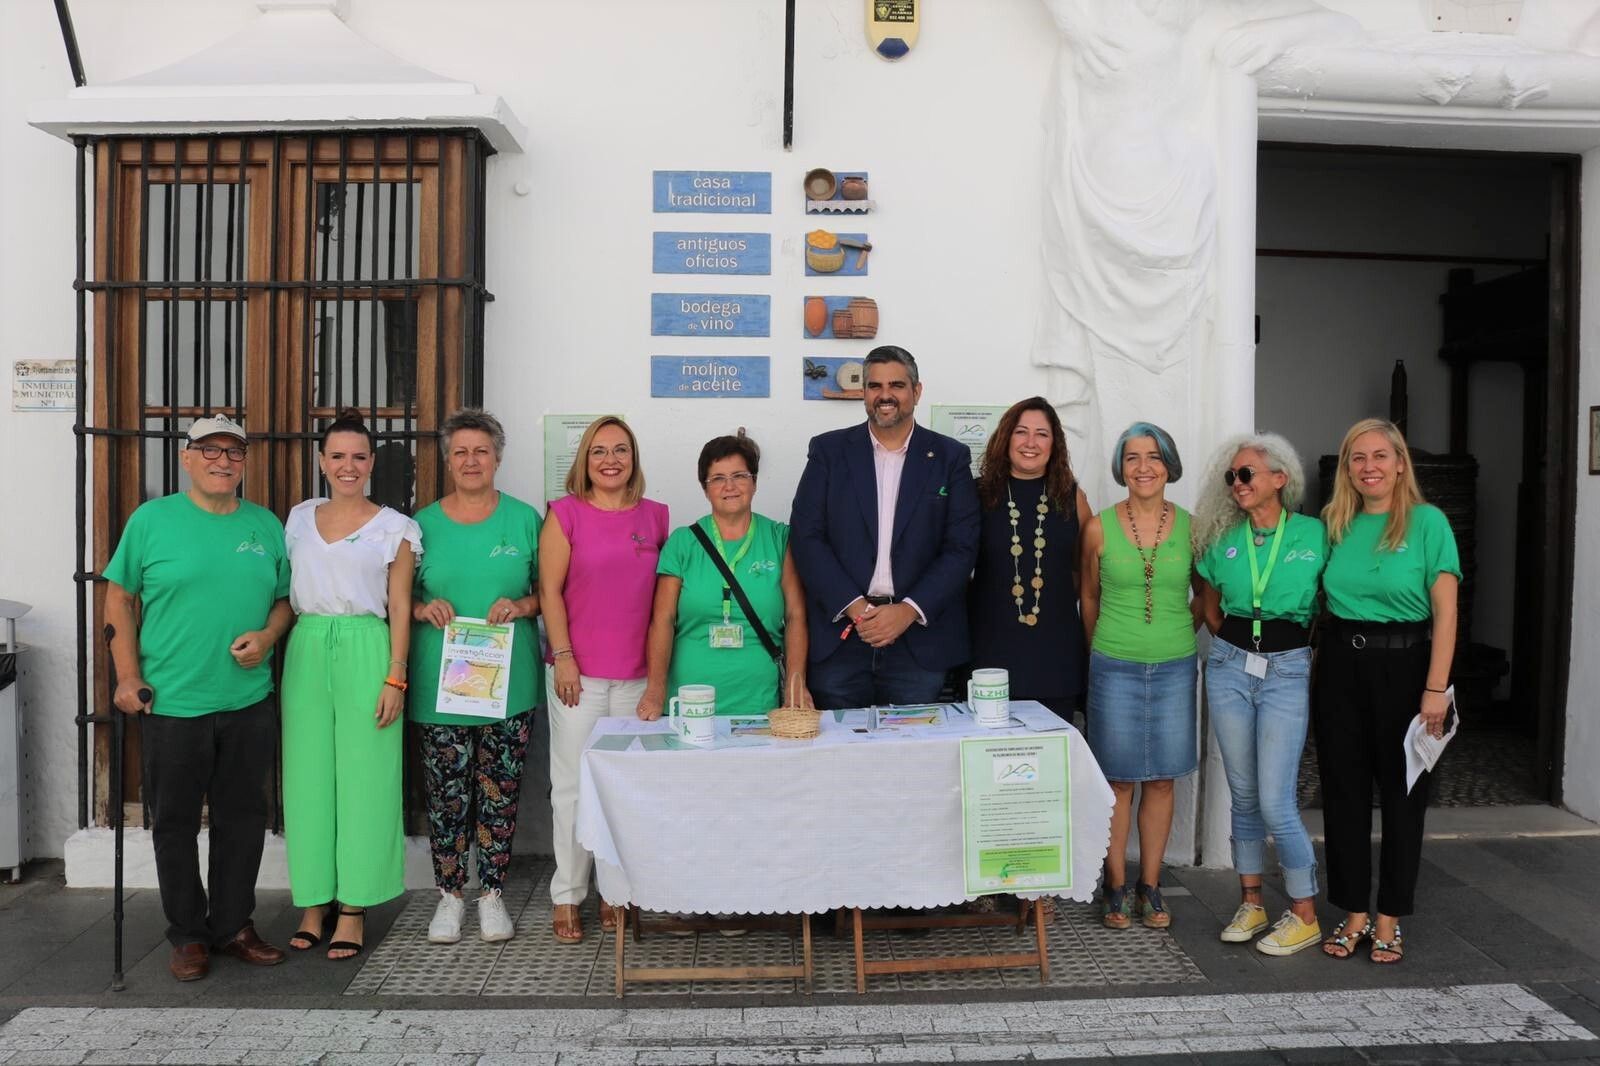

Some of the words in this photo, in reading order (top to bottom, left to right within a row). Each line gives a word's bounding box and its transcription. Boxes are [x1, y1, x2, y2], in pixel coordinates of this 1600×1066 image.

[693, 177, 731, 189] casa
[671, 193, 756, 208] tradicional
[677, 238, 747, 253] antiguos
[685, 254, 738, 268] oficios
[681, 300, 741, 316] bodega
[688, 322, 698, 330] de
[700, 317, 734, 330] vino
[682, 362, 738, 376] molino
[678, 382, 689, 391] de
[692, 378, 742, 392] aceite
